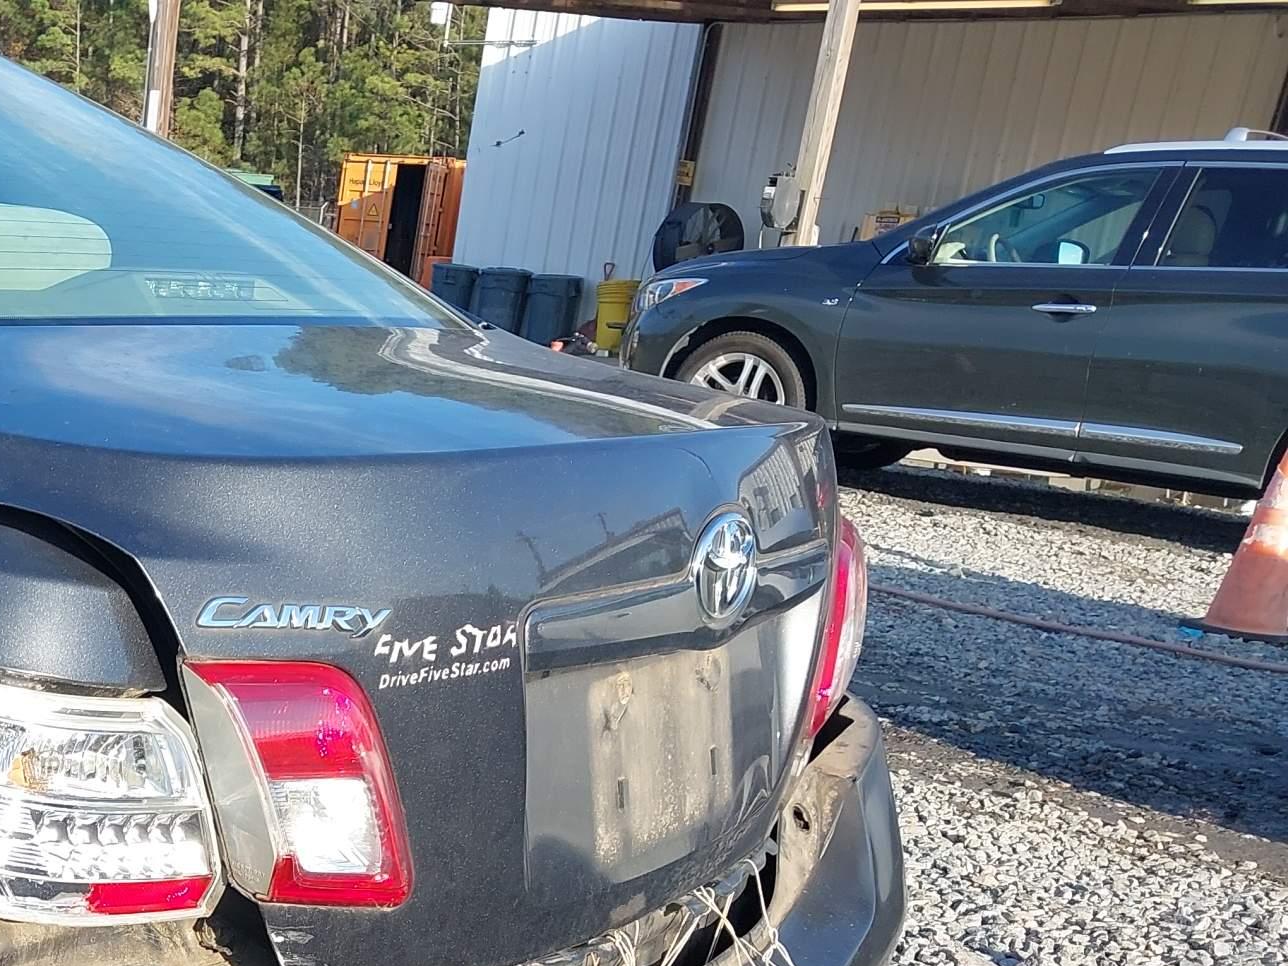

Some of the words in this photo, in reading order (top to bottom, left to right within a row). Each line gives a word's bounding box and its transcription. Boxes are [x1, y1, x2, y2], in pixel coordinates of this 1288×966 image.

[196, 596, 392, 638] CAMRY
[374, 633, 438, 664] FIVE
[378, 657, 510, 690] DriveFiveStar.com
